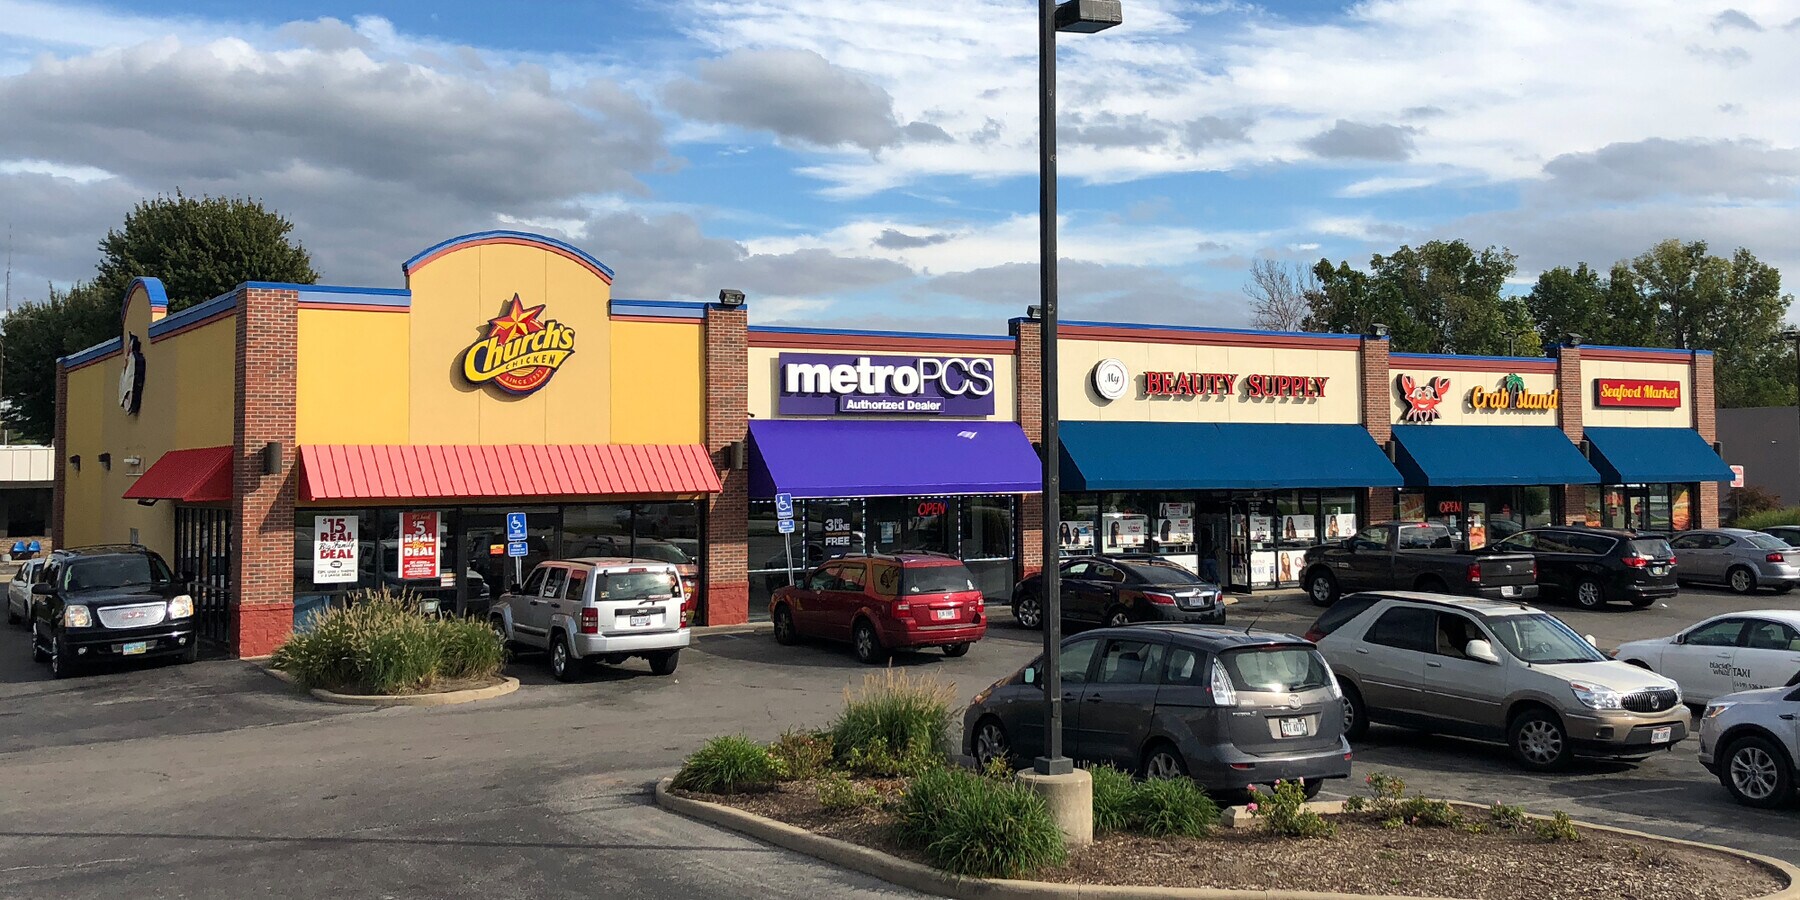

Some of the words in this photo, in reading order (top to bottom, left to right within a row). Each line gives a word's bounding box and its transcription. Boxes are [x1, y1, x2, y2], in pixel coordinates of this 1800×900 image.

[464, 320, 574, 382] Church's
[505, 354, 555, 370] CHICKEN
[505, 375, 528, 385] SINCE
[786, 357, 993, 396] metroPCS
[1105, 373, 1120, 385] My
[1143, 371, 1239, 396] BEAUTY
[1249, 373, 1330, 398] SUPPLY
[1473, 385, 1510, 409] Crab
[1601, 383, 1642, 402] Seafood
[1643, 385, 1679, 399] Market
[846, 399, 905, 411] Authorized
[907, 400, 942, 411] Dealer
[917, 502, 946, 516] OPEN
[1439, 501, 1462, 513] OPEN
[323, 518, 346, 533] $15
[413, 521, 426, 536] $5
[320, 532, 353, 541] REAL
[405, 534, 434, 542] REAL
[825, 536, 850, 546] FREE
[320, 549, 353, 559] DEAL
[405, 548, 434, 556] DEAL
[1733, 667, 1750, 678] TAXI
